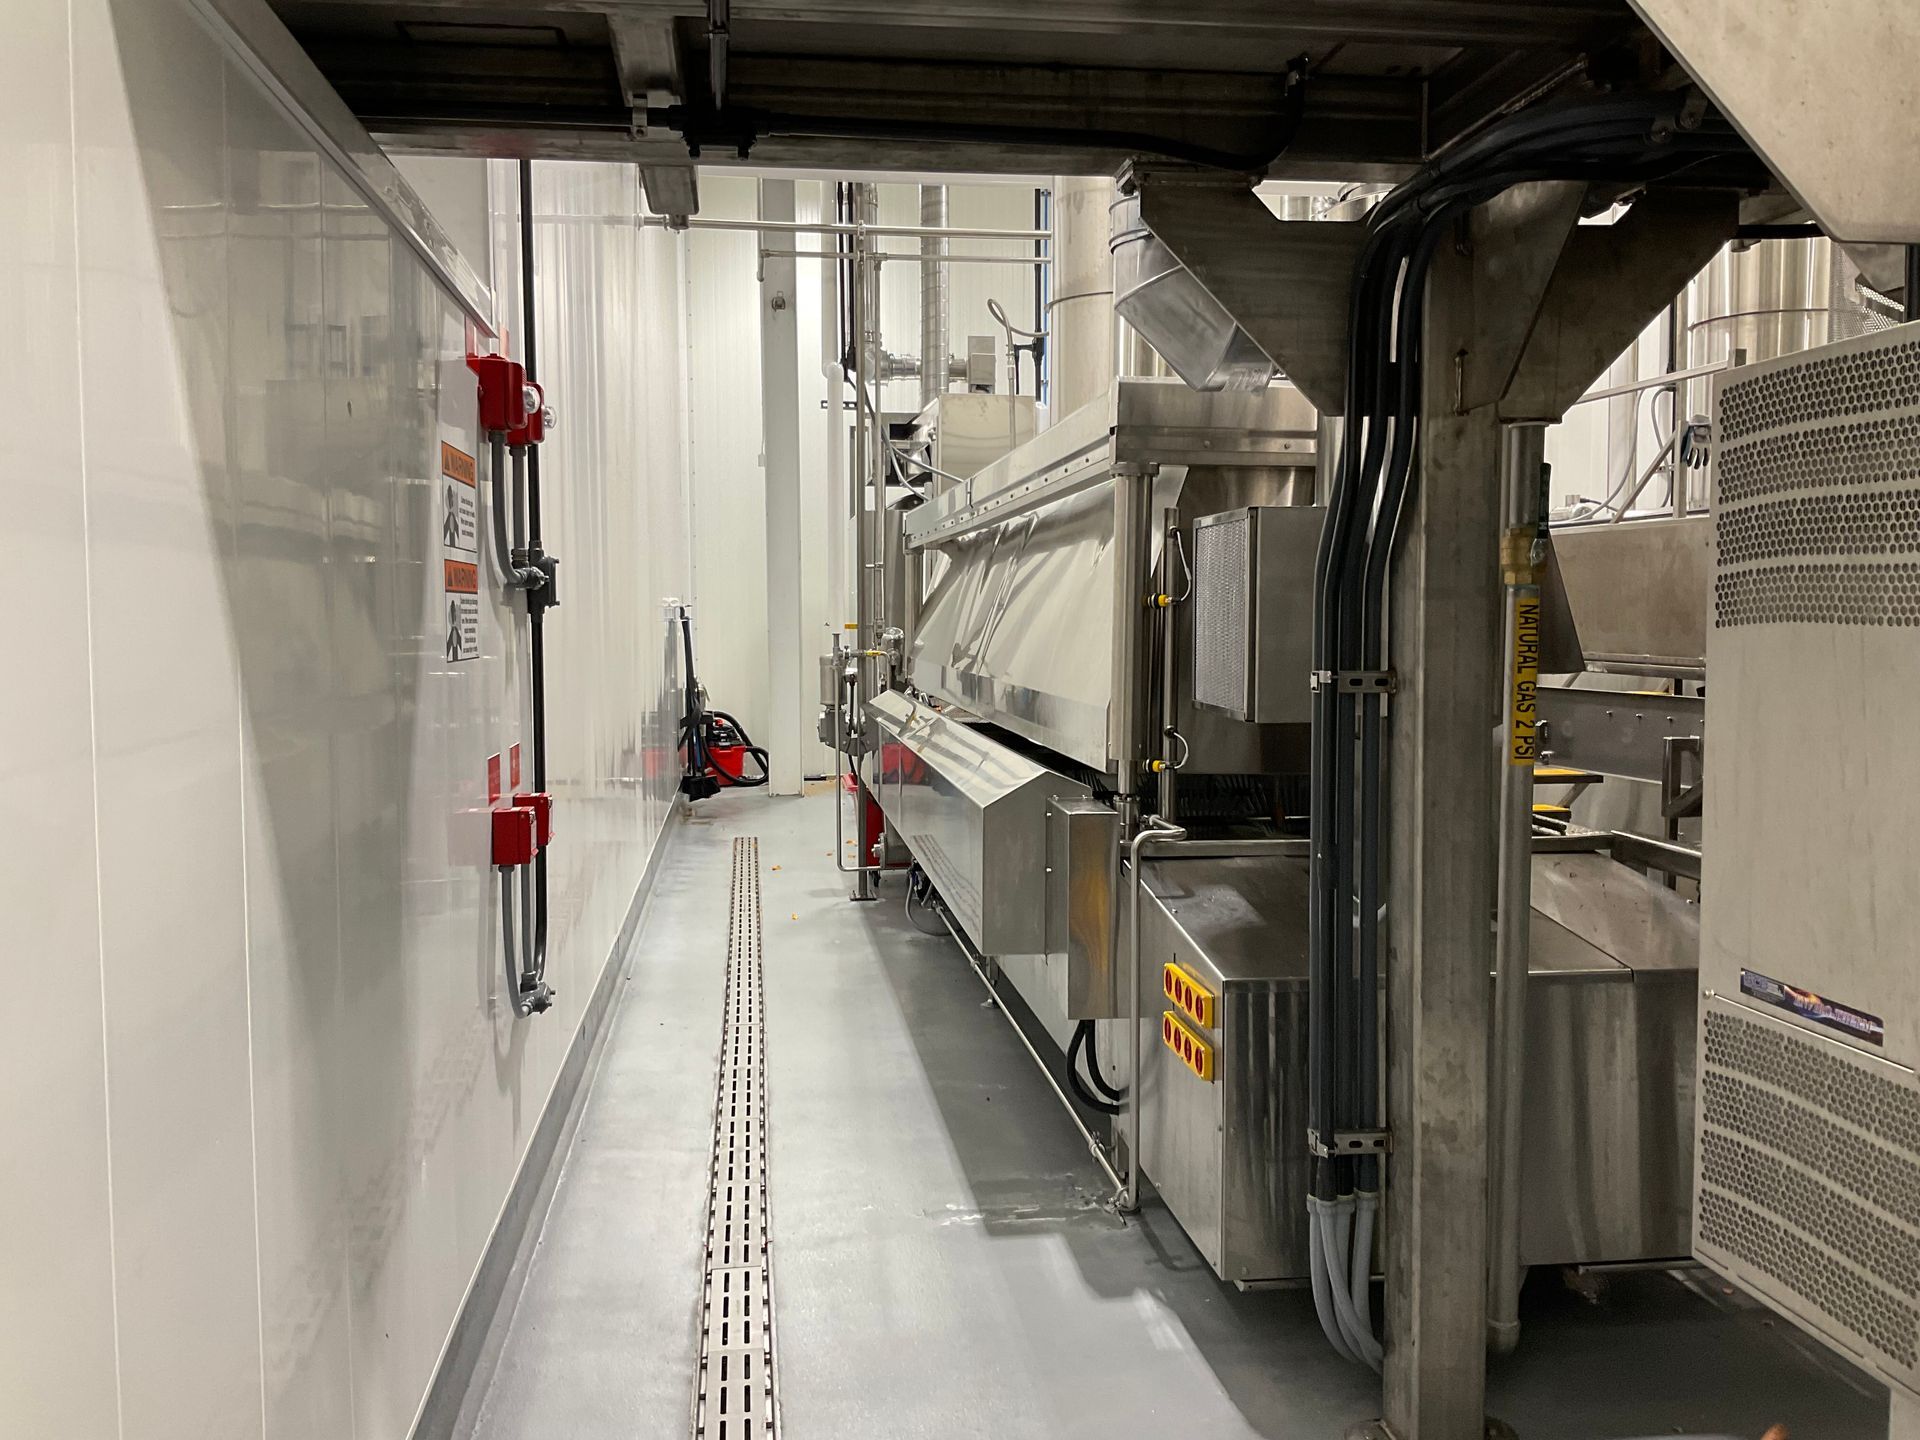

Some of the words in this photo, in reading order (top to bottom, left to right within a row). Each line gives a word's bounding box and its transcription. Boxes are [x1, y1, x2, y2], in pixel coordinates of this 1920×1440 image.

[1517, 604, 1539, 674] NATURAL
[1516, 680, 1537, 713] GAS
[1516, 720, 1534, 729] 2
[1515, 735, 1535, 760] PSI
